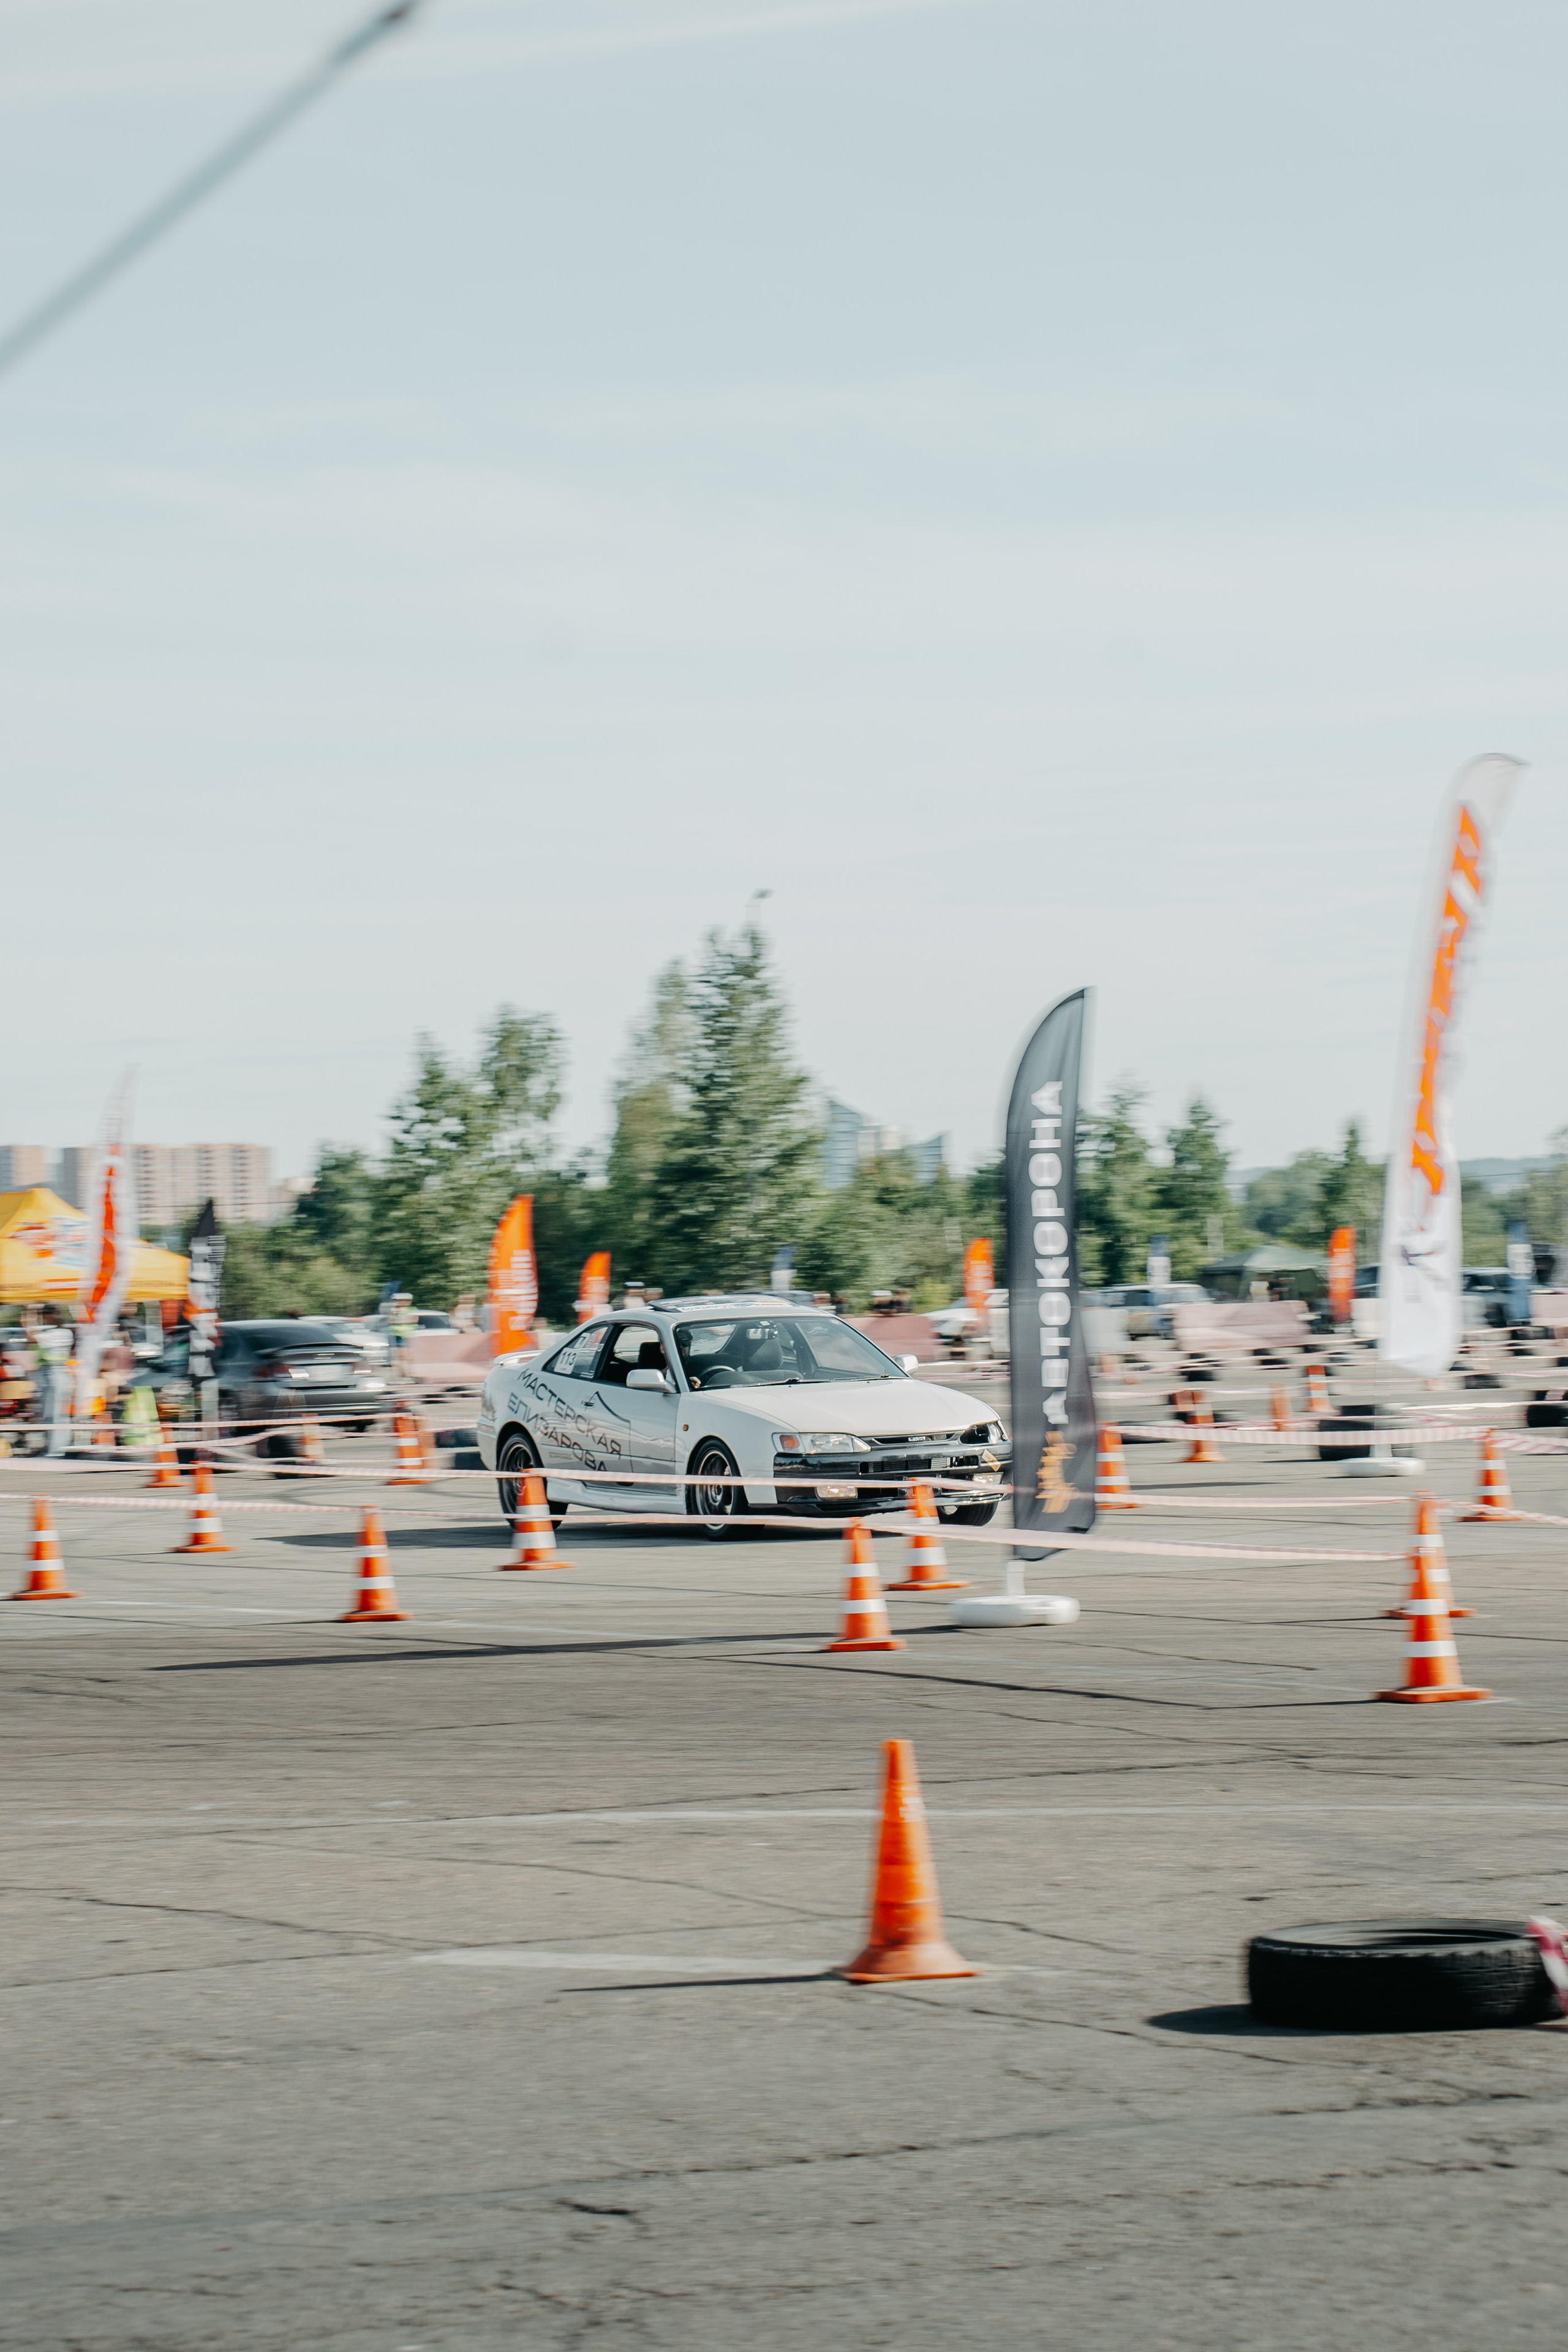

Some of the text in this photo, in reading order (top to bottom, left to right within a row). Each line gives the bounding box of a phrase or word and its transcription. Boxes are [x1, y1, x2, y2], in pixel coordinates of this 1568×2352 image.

[1028, 1080, 1071, 1425] АВТОКОРОНА
[559, 1351, 576, 1366] 113
[517, 1368, 621, 1460] МАСТЕРСКАЯ
